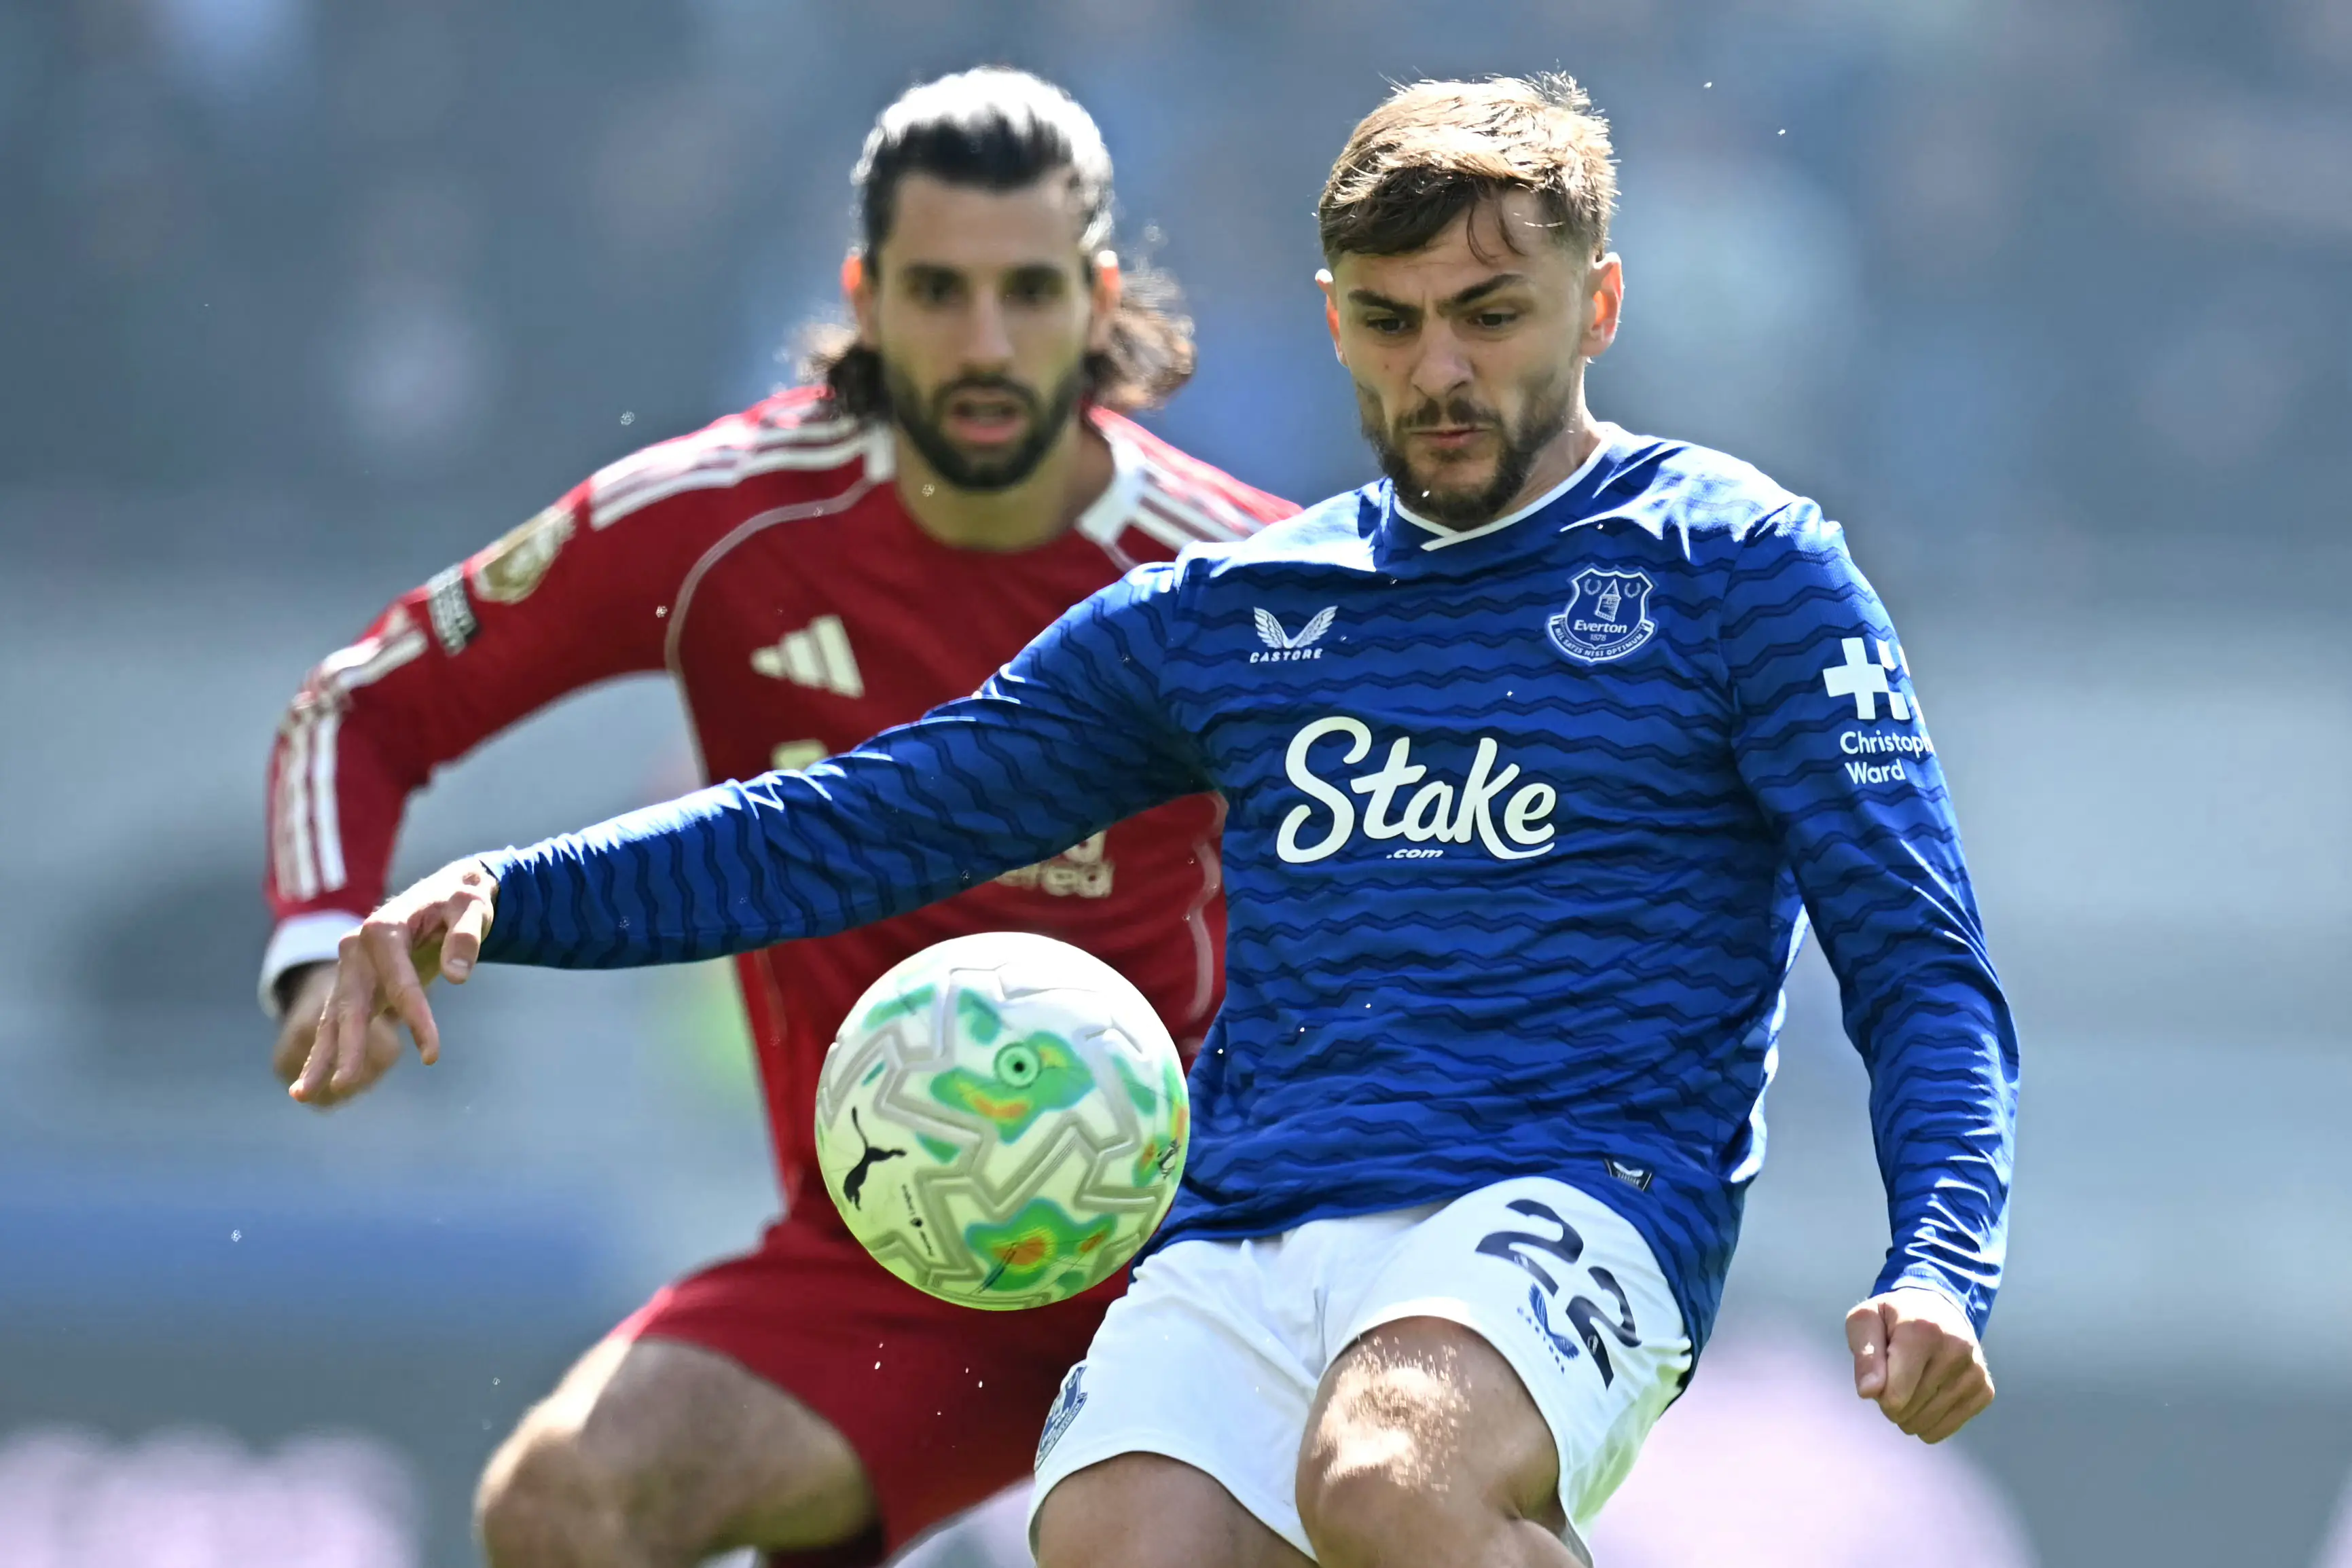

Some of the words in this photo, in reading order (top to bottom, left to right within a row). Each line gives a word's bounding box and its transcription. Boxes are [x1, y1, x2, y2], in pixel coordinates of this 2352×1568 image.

[1574, 619, 1627, 634] Everton
[1590, 634, 1607, 642] 1878
[1250, 648, 1323, 663] CASTORE
[1845, 758, 1906, 784] Ward
[1276, 716, 1557, 863] Stake
[1386, 847, 1444, 859] .com
[1474, 1198, 1642, 1391] 22
